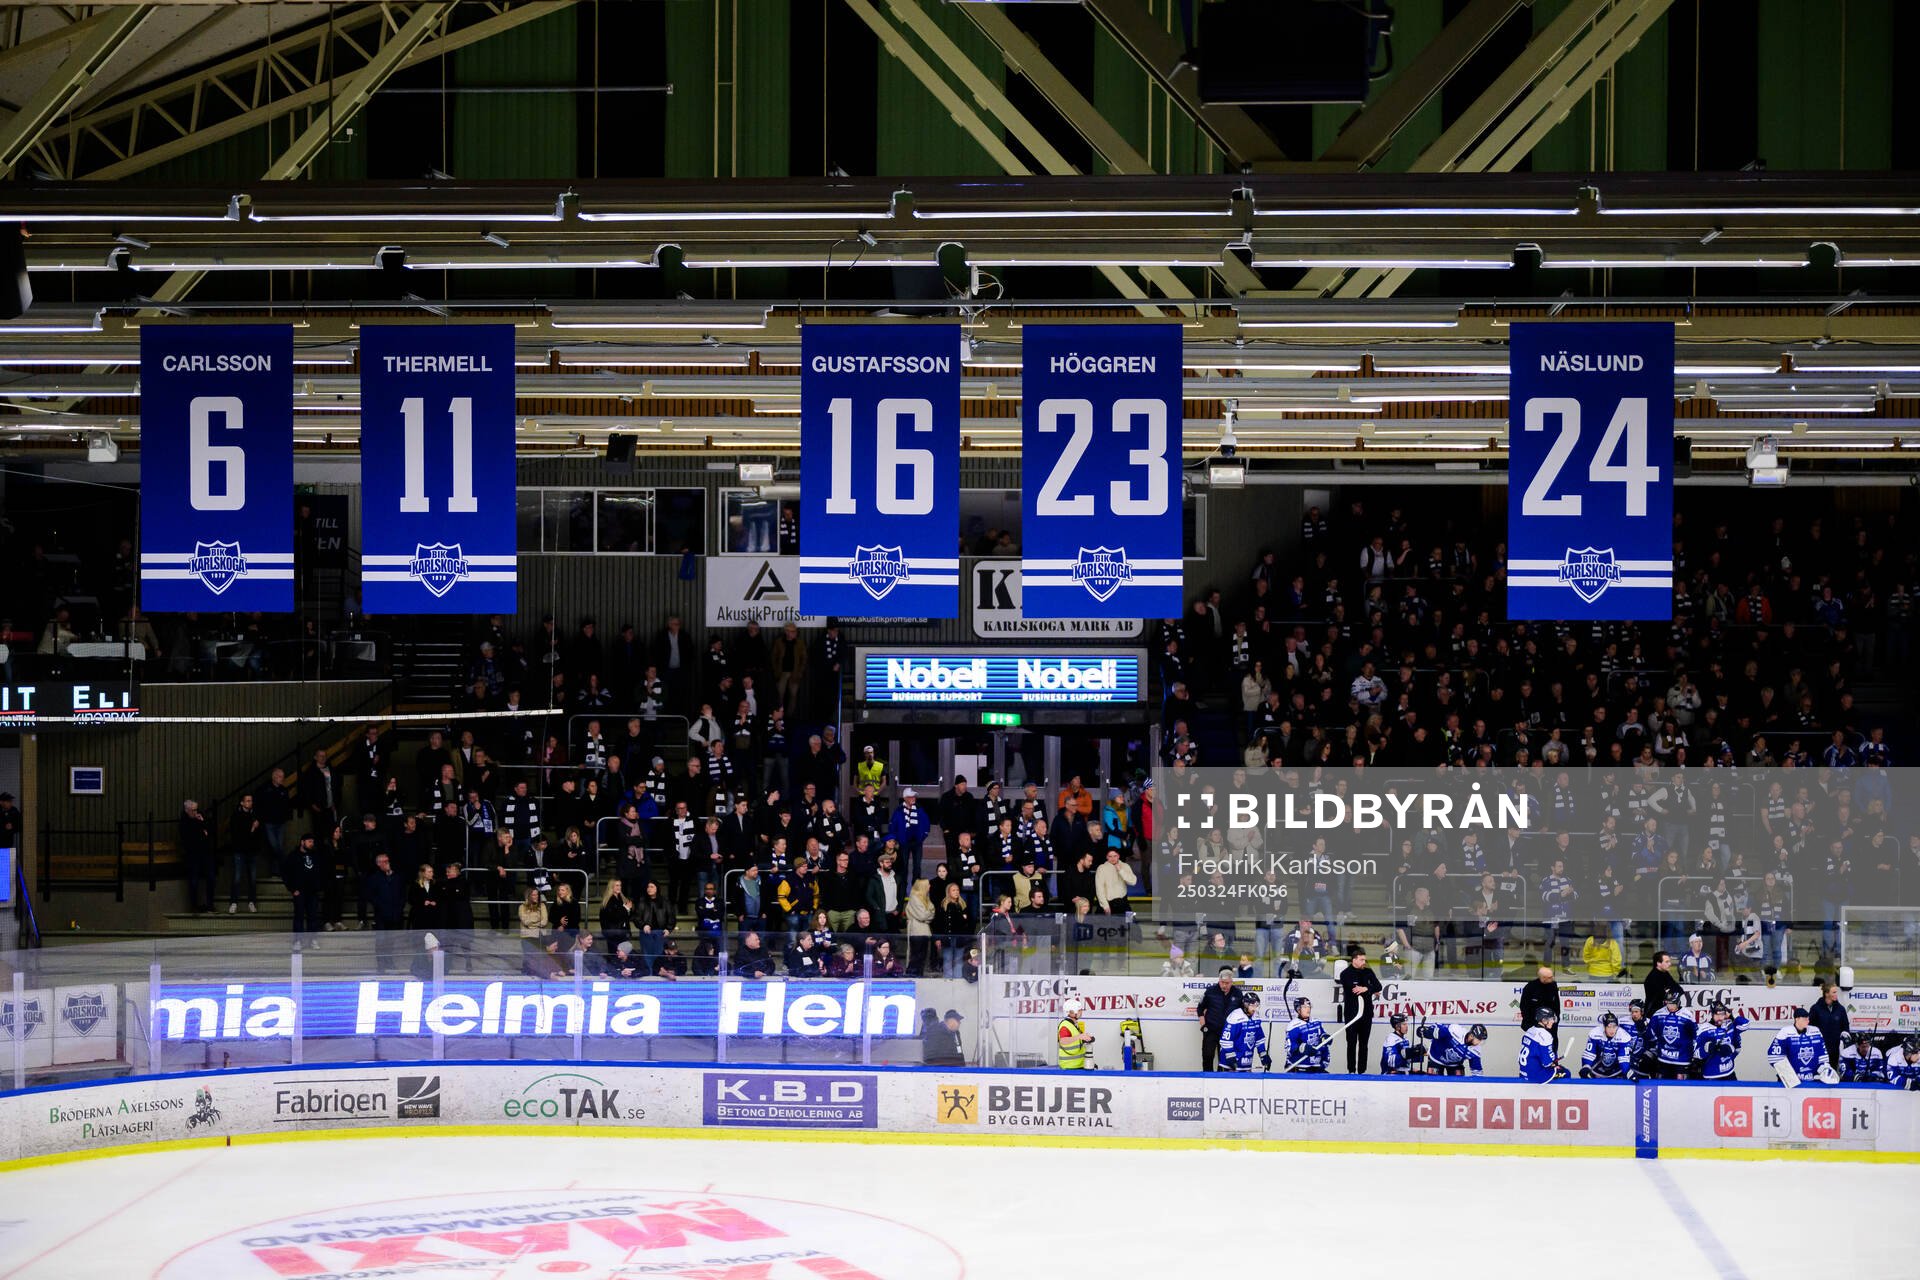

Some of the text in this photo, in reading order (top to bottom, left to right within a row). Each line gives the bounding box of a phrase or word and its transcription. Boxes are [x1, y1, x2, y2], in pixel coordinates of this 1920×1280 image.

[162, 354, 272, 372] CARLSSON
[383, 355, 493, 373] THERMELL
[811, 355, 950, 374] GUSTAFSSON
[1050, 352, 1156, 374] HÖGGREN
[1540, 350, 1644, 372] NÄSLUND
[189, 396, 246, 511] 6
[399, 397, 478, 513] 11
[825, 398, 934, 515] 16
[1036, 398, 1169, 516] 23
[1522, 397, 1660, 517] 24
[315, 518, 339, 529] TILL
[211, 548, 226, 557] BIK
[314, 537, 341, 550] EN
[431, 550, 447, 559] BIK
[871, 552, 887, 561] BIK
[1094, 554, 1110, 562] BIK
[1582, 555, 1597, 563] BIK
[191, 557, 246, 573] KARLSKOGA
[412, 559, 467, 575] KARLSKOGA
[851, 561, 907, 577] KARLSKOGA
[1074, 563, 1131, 579] KARLSKOGA
[1561, 563, 1619, 580] KARLSKOGA
[983, 620, 1134, 632] KARLSKOGA MARK AB
[891, 692, 983, 701] BUSINESS SUPPORT
[1021, 692, 1113, 701] BUSINESS SUPPORT
[1017, 993, 1166, 1015] BETNTEN.se
[1684, 988, 1741, 1008] YGG-
[1849, 992, 1888, 1000] HEBAB
[62, 1006, 107, 1020] KARLSKOGA
[150, 984, 296, 1038] mia
[355, 981, 661, 1036] Helmia
[1375, 997, 1498, 1018] TJÄNTEN.se
[0, 1011, 44, 1028] ARKOGA
[1771, 1046, 1782, 1055] 30
[717, 1079, 864, 1103] K.B.D
[988, 1085, 1113, 1114] BEIJER
[49, 1097, 184, 1124] BRÖDERNA AXELSSONS
[276, 1088, 387, 1115] Fabriqen
[1209, 1096, 1346, 1117] PARTNERTECH
[717, 1105, 863, 1120] BETONG DEMOLERING AB
[1414, 1101, 1584, 1127] CRAMO
[1719, 1104, 1781, 1128] ka it
[1808, 1105, 1869, 1130] ka it
[82, 1120, 154, 1139] PLÅTSLAGERI
[988, 1116, 1113, 1128] BYGGMATERIAL
[240, 1205, 638, 1248] STORMARKNAD
[249, 1206, 790, 1277] MAXI
